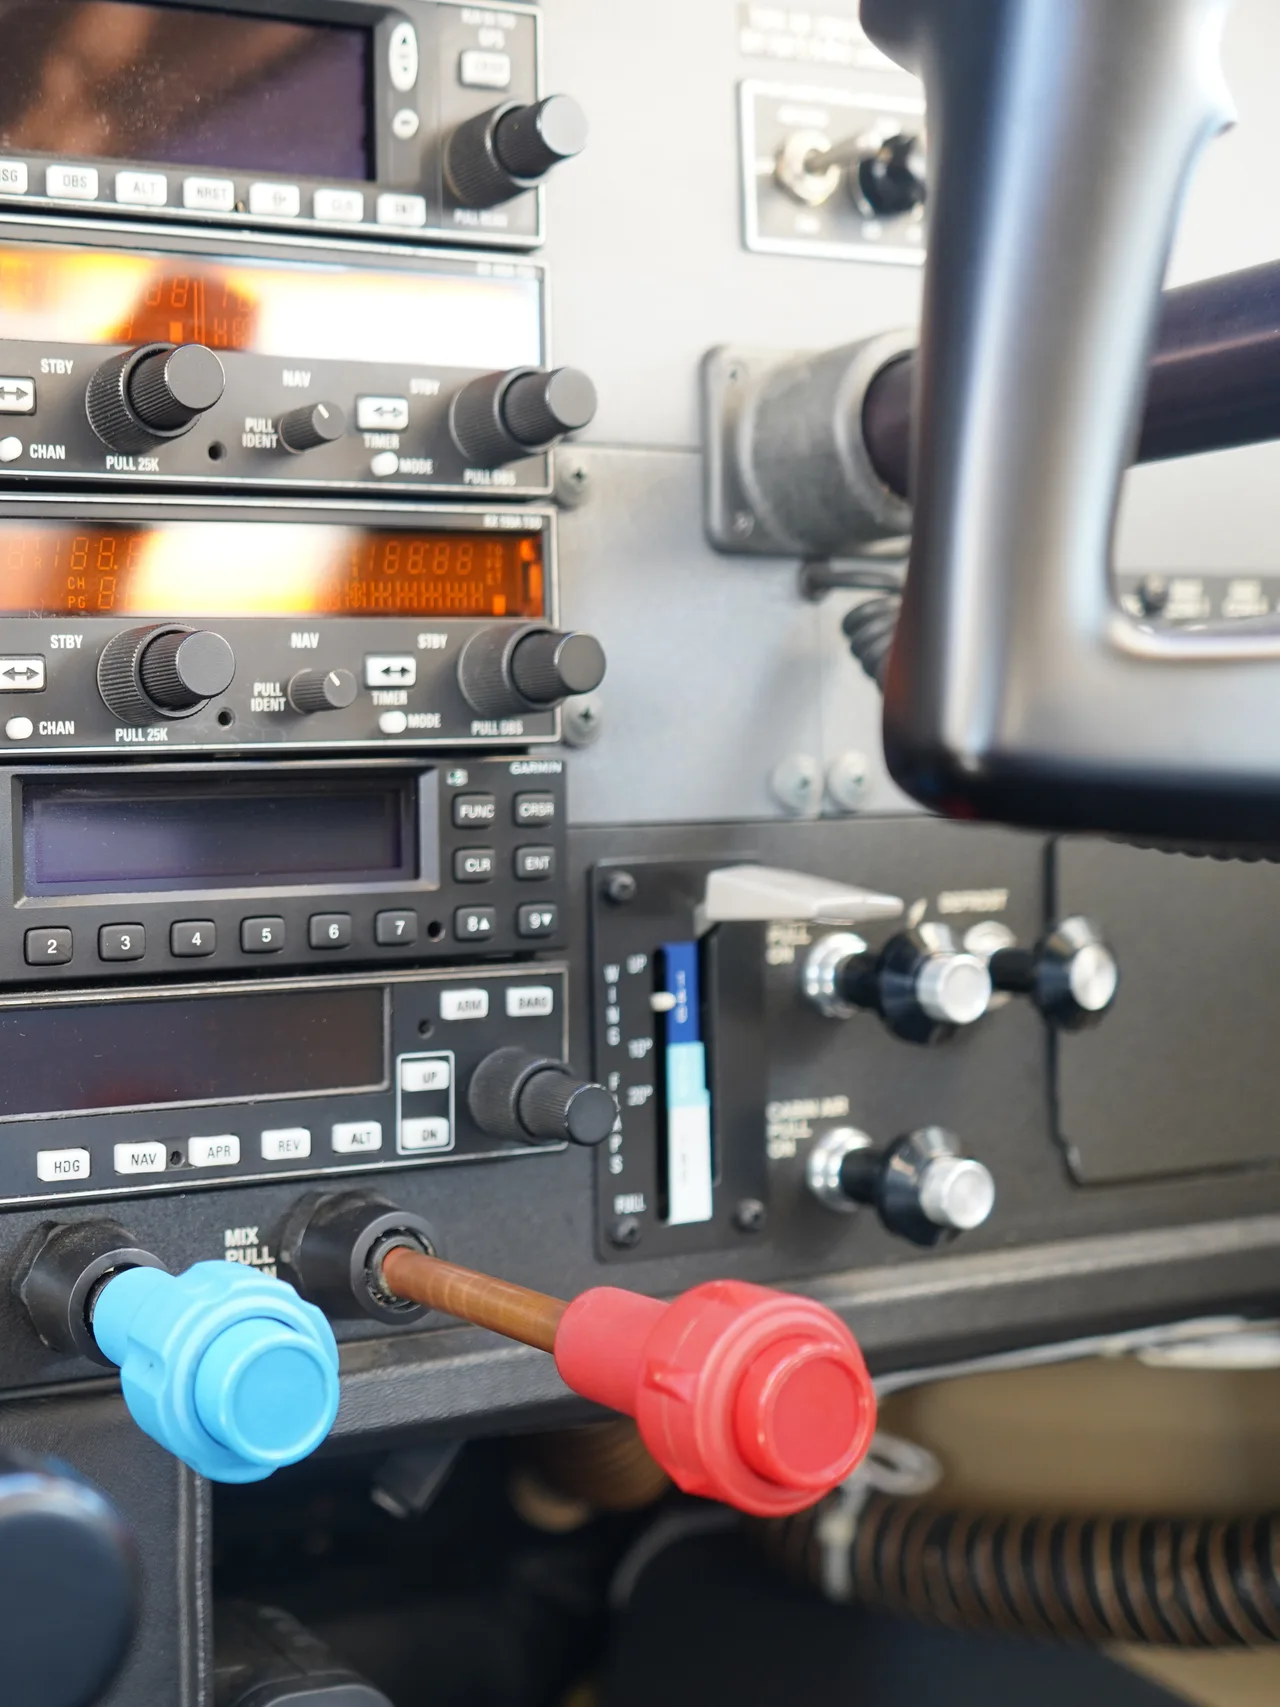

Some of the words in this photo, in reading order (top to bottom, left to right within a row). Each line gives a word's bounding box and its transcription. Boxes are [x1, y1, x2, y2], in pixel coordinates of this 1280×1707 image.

[62, 174, 88, 189] OBS
[132, 180, 157, 195] ALT
[40, 358, 74, 375] STBY
[282, 370, 311, 388] NAV
[410, 378, 440, 396] STBY
[244, 417, 275, 434] PULL
[241, 433, 279, 449] IDENT
[363, 433, 399, 450] TIMER
[29, 444, 66, 460] CHAN
[106, 455, 137, 472] PULL
[138, 457, 160, 472] 25K
[399, 458, 434, 475] MODE
[67, 576, 86, 591] CH
[67, 595, 87, 609] PG
[50, 634, 83, 650] STBY
[291, 632, 320, 649] NAV
[417, 633, 448, 650] STBY
[253, 682, 283, 697] PULL
[250, 697, 286, 713] IDENT
[371, 690, 408, 706] TIMER
[38, 720, 75, 736] CHAN
[407, 713, 442, 729] MODE
[471, 720, 499, 736] PULL
[115, 727, 146, 743] PULL
[146, 727, 169, 742] 25K
[459, 804, 495, 820] FUNC
[464, 857, 491, 873] CLR
[524, 855, 551, 871] ENT
[328, 924, 340, 940] 6
[394, 920, 406, 935] 7
[120, 935, 131, 951] 3
[191, 932, 203, 948] 4
[261, 928, 272, 944] 5
[46, 939, 58, 955] 2
[456, 997, 482, 1012] ARM
[423, 1070, 438, 1084] UP
[350, 1131, 372, 1146] ALT
[422, 1127, 438, 1142] DN
[206, 1144, 232, 1159] APR
[277, 1139, 301, 1154] REV
[54, 1159, 81, 1174] HDG
[131, 1153, 157, 1167] NAV
[224, 1226, 260, 1248] MIX
[224, 1245, 276, 1265] PULL
